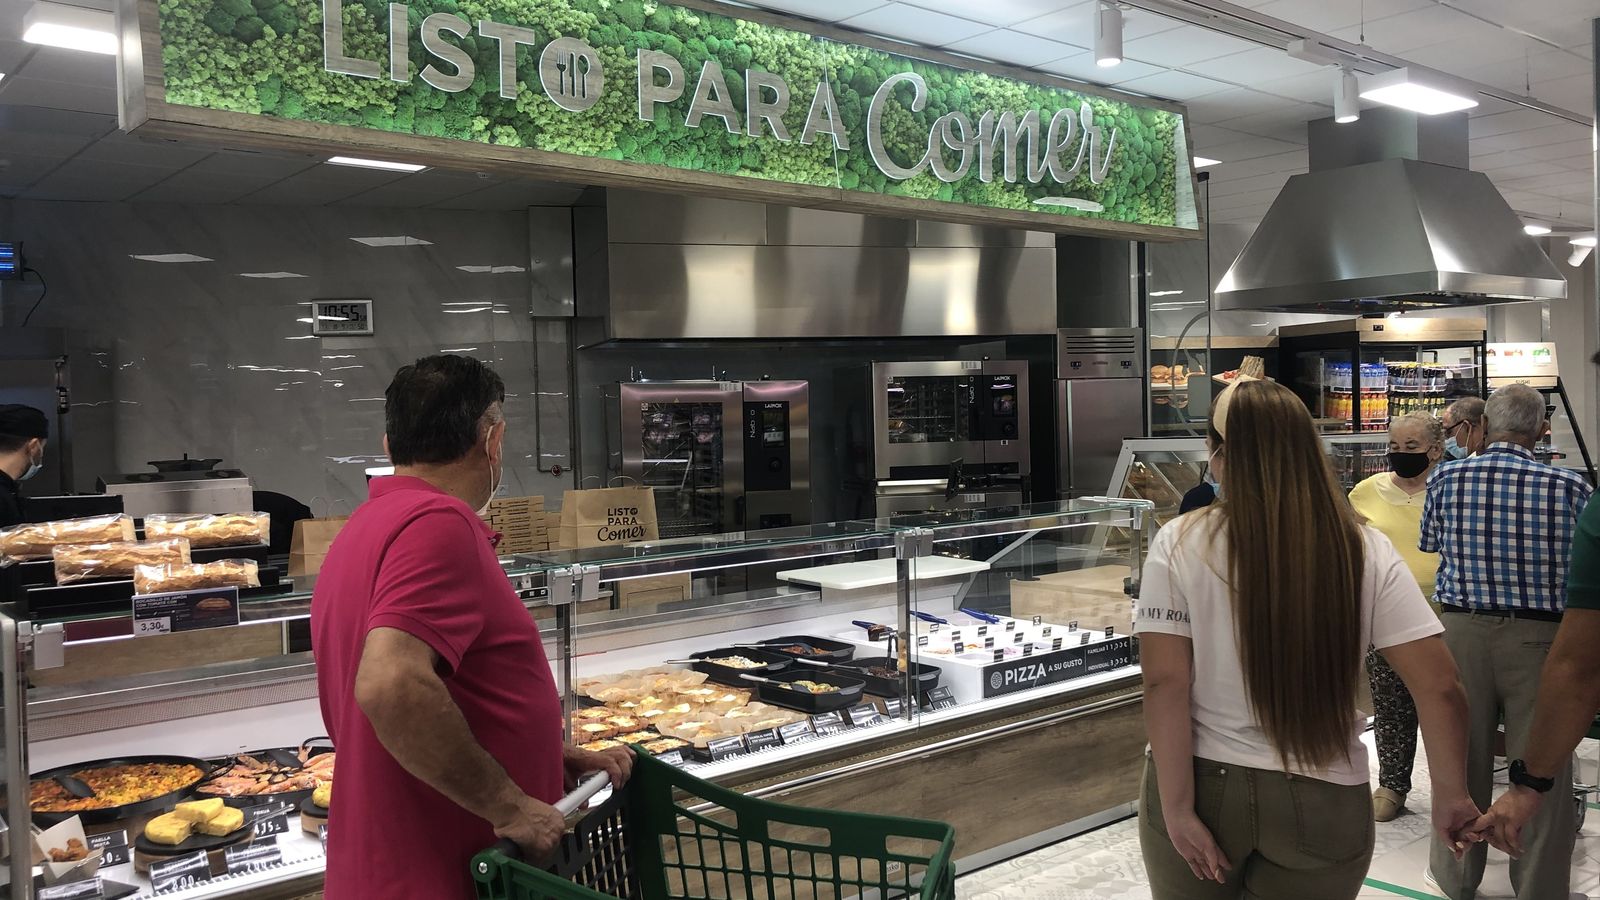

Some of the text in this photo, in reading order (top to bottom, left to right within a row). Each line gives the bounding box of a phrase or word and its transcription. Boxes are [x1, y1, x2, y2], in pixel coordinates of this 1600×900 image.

[323, 0, 1116, 184] LISTO PARA Comer
[607, 507, 639, 517] LISTO
[607, 517, 638, 526] PARA
[597, 525, 647, 541] Comer
[1148, 607, 1164, 619] MY
[1166, 609, 1191, 624] ROA
[1004, 658, 1083, 686] PIZZA A SU GUSTO
